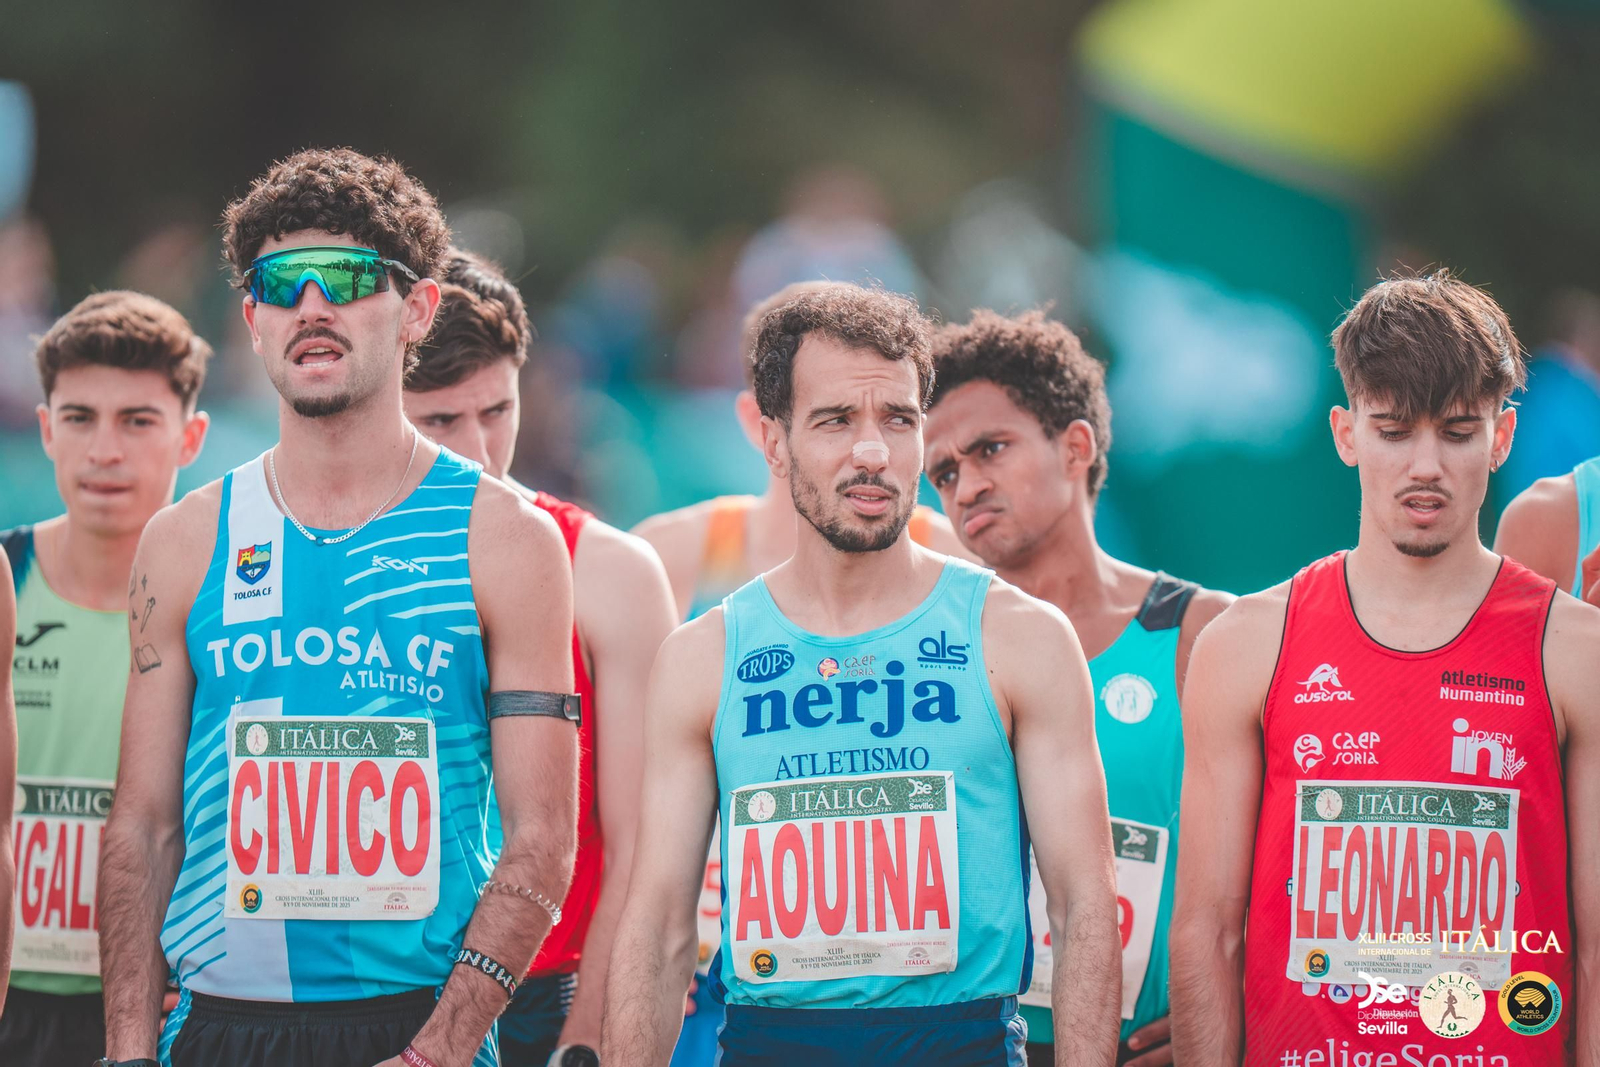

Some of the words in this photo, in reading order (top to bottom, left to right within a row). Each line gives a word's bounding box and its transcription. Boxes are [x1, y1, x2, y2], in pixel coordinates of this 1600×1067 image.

[233, 588, 261, 600] TOLOSA
[207, 626, 392, 677] TOLOSA
[407, 635, 454, 678] CF
[740, 652, 792, 679] TROPS
[1441, 670, 1526, 691] Atletismo
[742, 660, 961, 738] nerja
[1440, 686, 1525, 707] Numantino
[279, 724, 378, 749] ITÁLICA
[1471, 730, 1513, 745] JOVEN
[775, 746, 930, 780] ATLETISMO
[37, 787, 111, 814] ITÁLIC
[790, 785, 892, 812] ITÁLICA
[1357, 789, 1457, 818] ITÁLICA
[230, 759, 431, 877] CIVICO
[790, 810, 840, 818] INTERNATIONAL
[1472, 818, 1496, 826] Sevilla
[14, 820, 105, 930] GAL
[736, 816, 951, 941] AOUINA
[1296, 825, 1507, 947] LEONARDO
[808, 955, 851, 963] INTERNACIONAL
[821, 960, 852, 968] NOVIEMBRE
[1280, 1038, 1509, 1067] #eligeSoria
